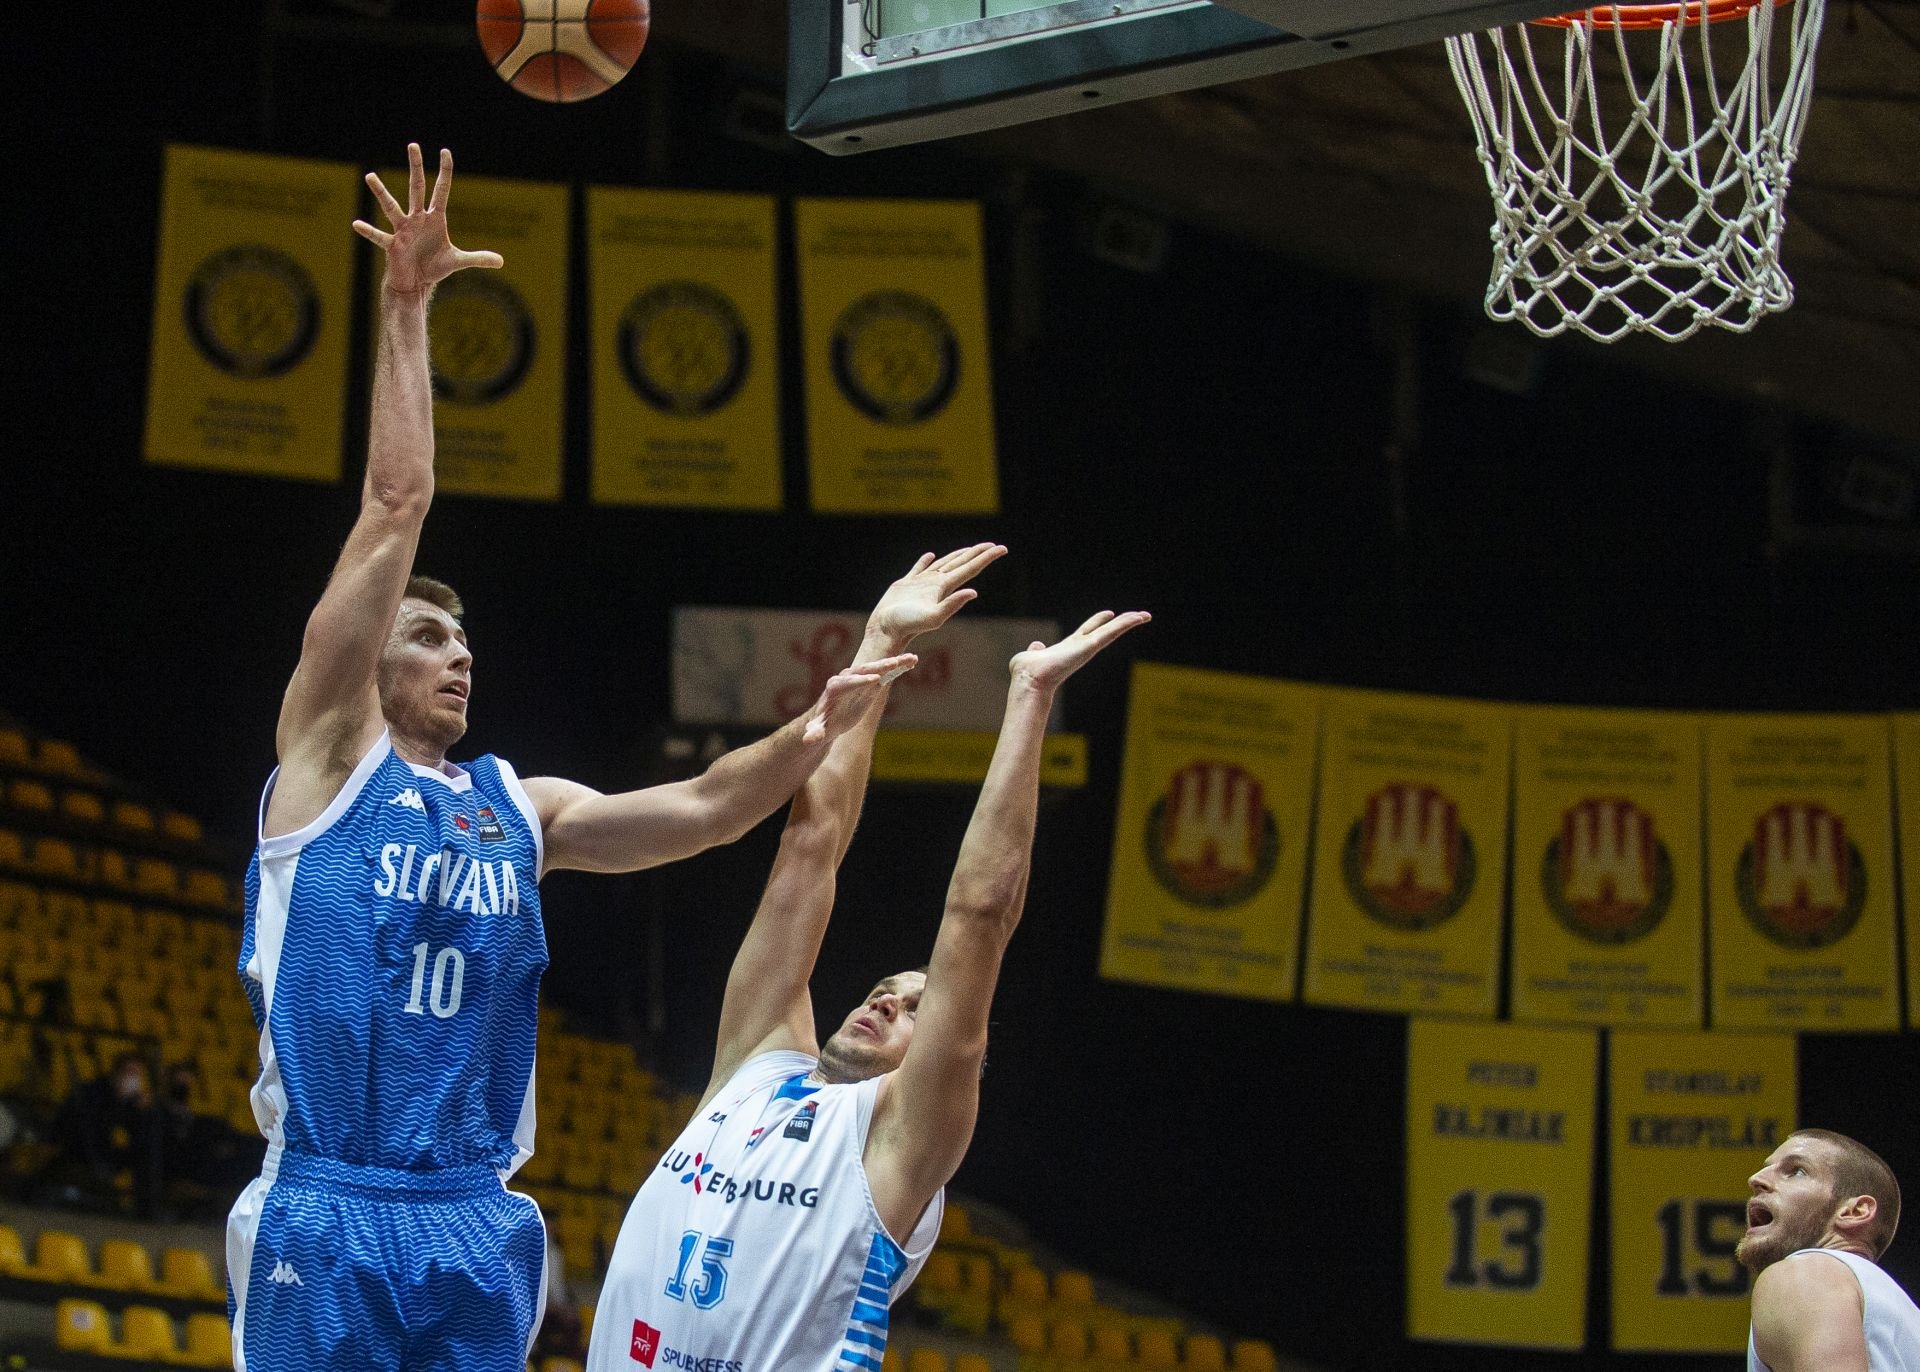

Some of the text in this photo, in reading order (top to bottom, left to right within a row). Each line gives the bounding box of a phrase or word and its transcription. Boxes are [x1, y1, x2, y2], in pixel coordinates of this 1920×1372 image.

[480, 825, 499, 833] FIBA
[374, 843, 519, 916] SLOVAIA
[404, 942, 465, 1019] 10
[789, 1120, 809, 1130] FIBA
[663, 1229, 734, 1311] 15
[1445, 1189, 1545, 1292] 13
[1656, 1198, 1751, 1297] 15
